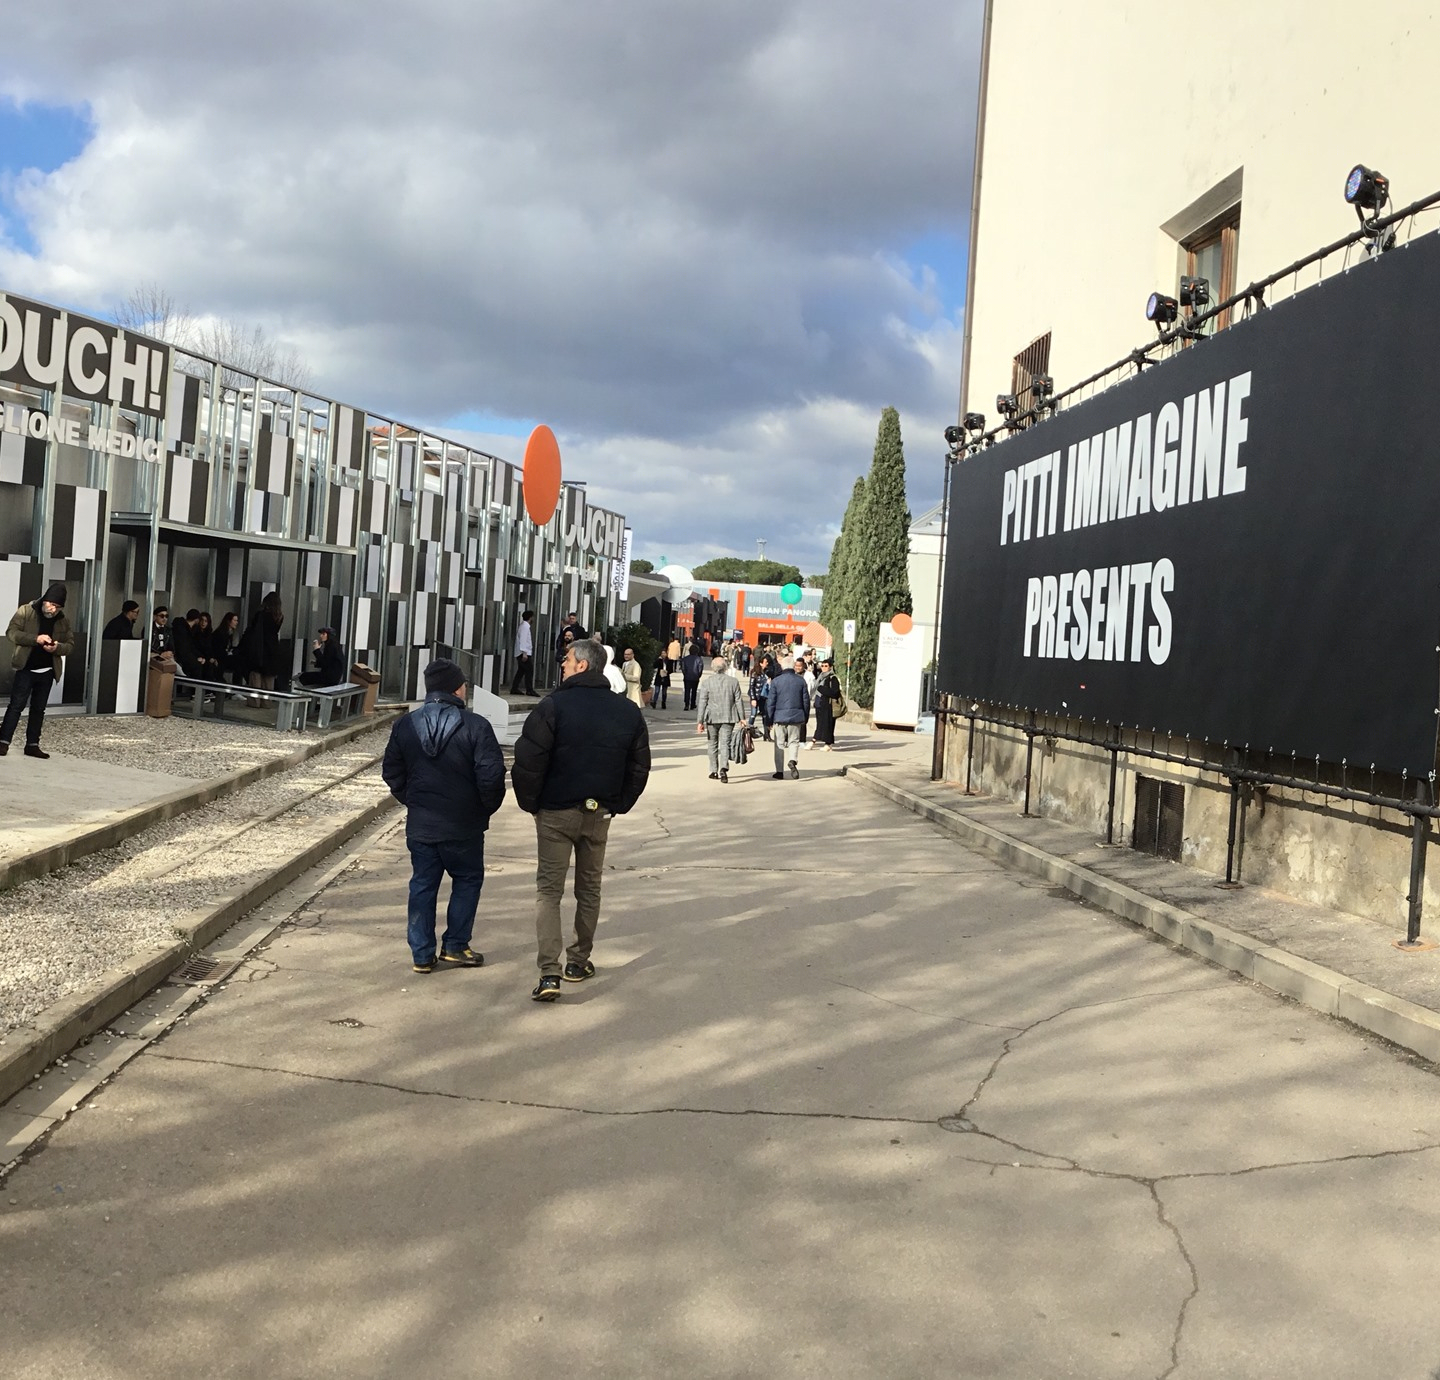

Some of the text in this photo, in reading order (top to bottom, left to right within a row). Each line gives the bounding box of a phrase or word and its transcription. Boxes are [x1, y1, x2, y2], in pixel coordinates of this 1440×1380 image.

[87, 424, 164, 464] MEDICI
[1000, 370, 1252, 546] PITTI IMMAGINE
[747, 605, 779, 615] URBAN
[1023, 557, 1176, 666] PRESENTS
